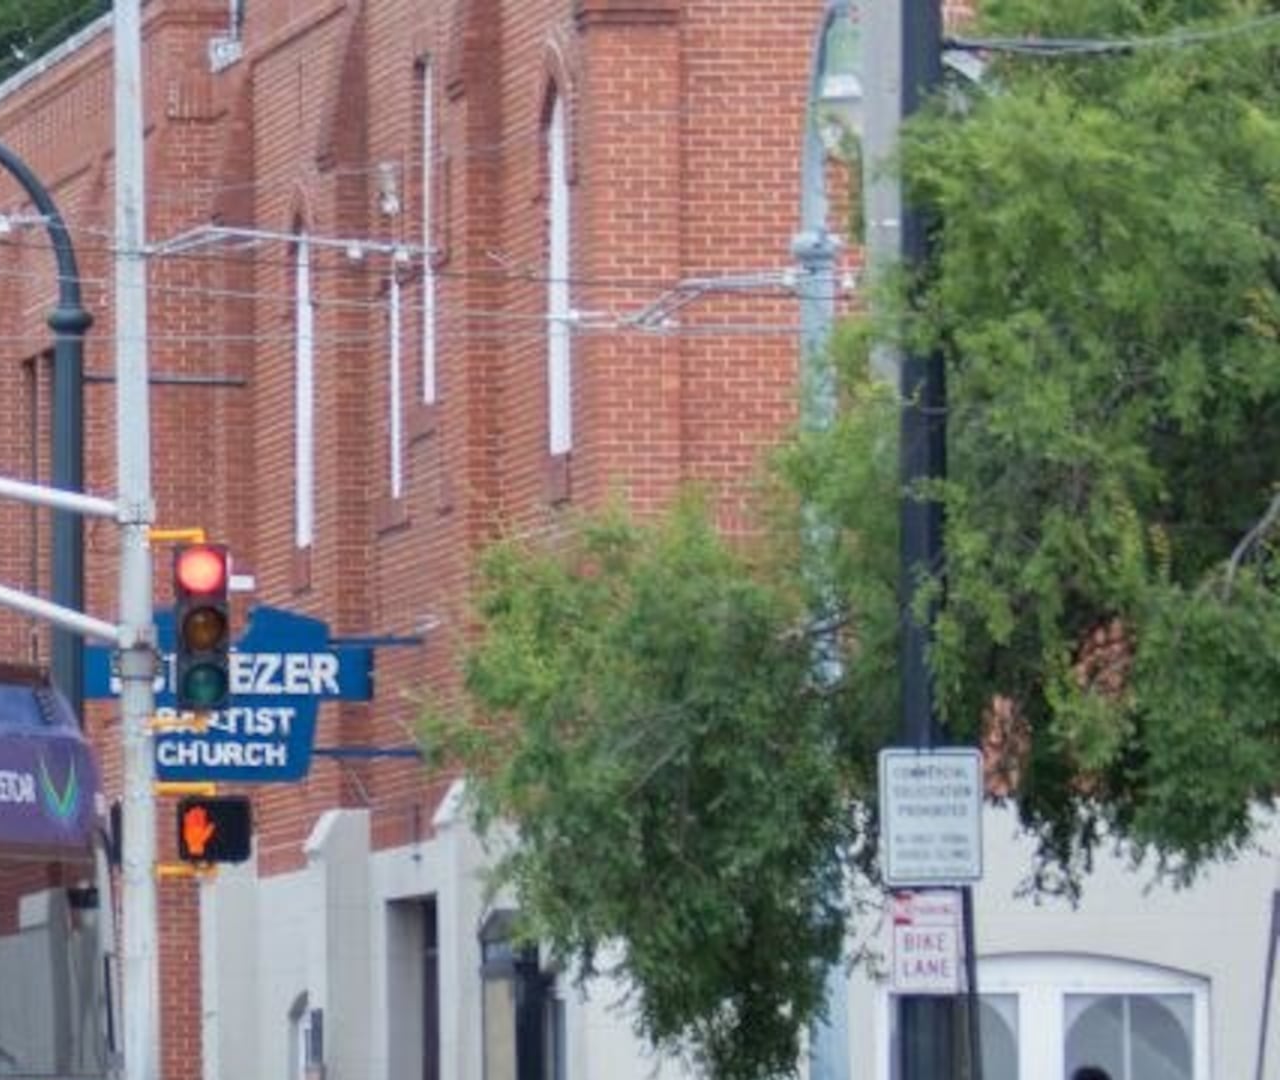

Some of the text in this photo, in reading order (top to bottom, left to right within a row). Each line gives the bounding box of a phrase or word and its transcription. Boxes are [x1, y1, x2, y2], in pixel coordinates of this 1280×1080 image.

[157, 740, 287, 767] CHURCH
[904, 931, 948, 952] BIKE
[903, 957, 951, 978] LANE
